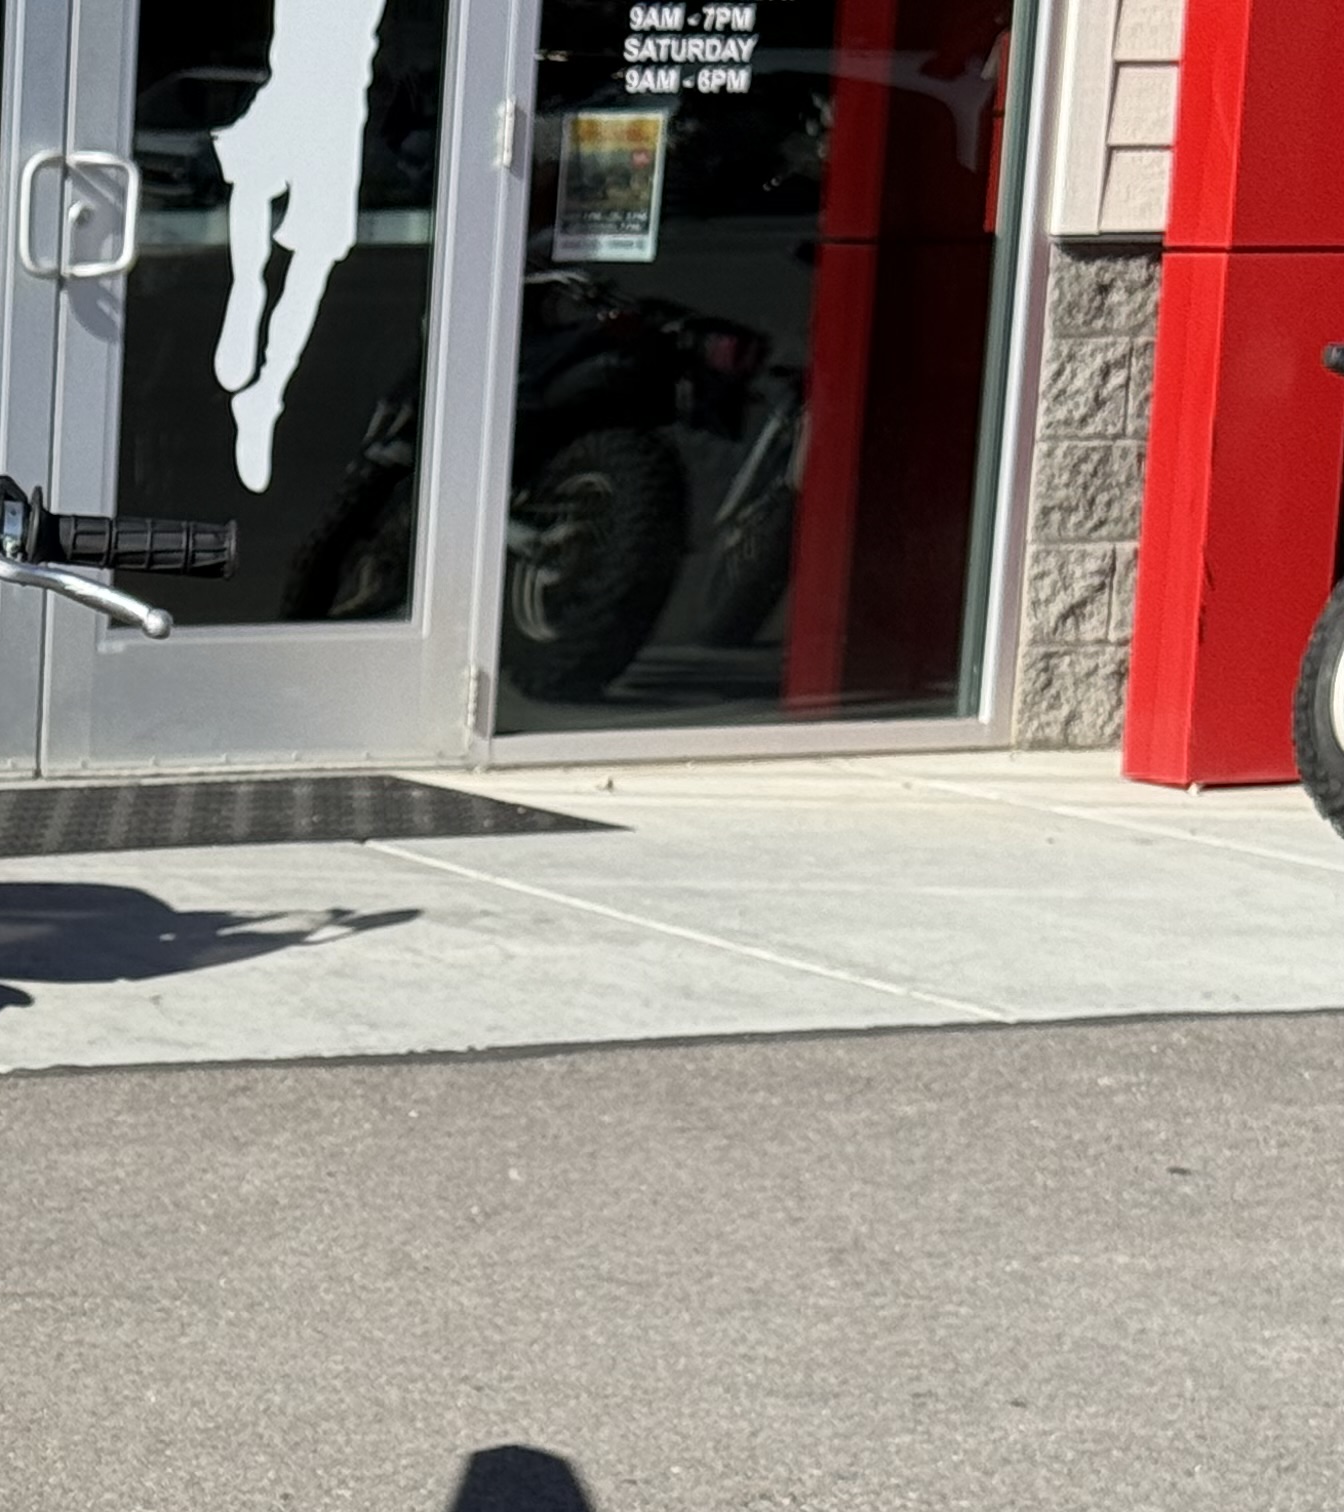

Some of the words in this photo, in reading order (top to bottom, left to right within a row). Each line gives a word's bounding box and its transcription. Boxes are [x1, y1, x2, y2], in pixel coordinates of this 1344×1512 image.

[629, 4, 685, 31] 9AM
[702, 4, 756, 31] 7PM
[623, 34, 758, 62] SATURDAY
[625, 66, 680, 93] 9AM
[697, 66, 752, 93] 6PM
